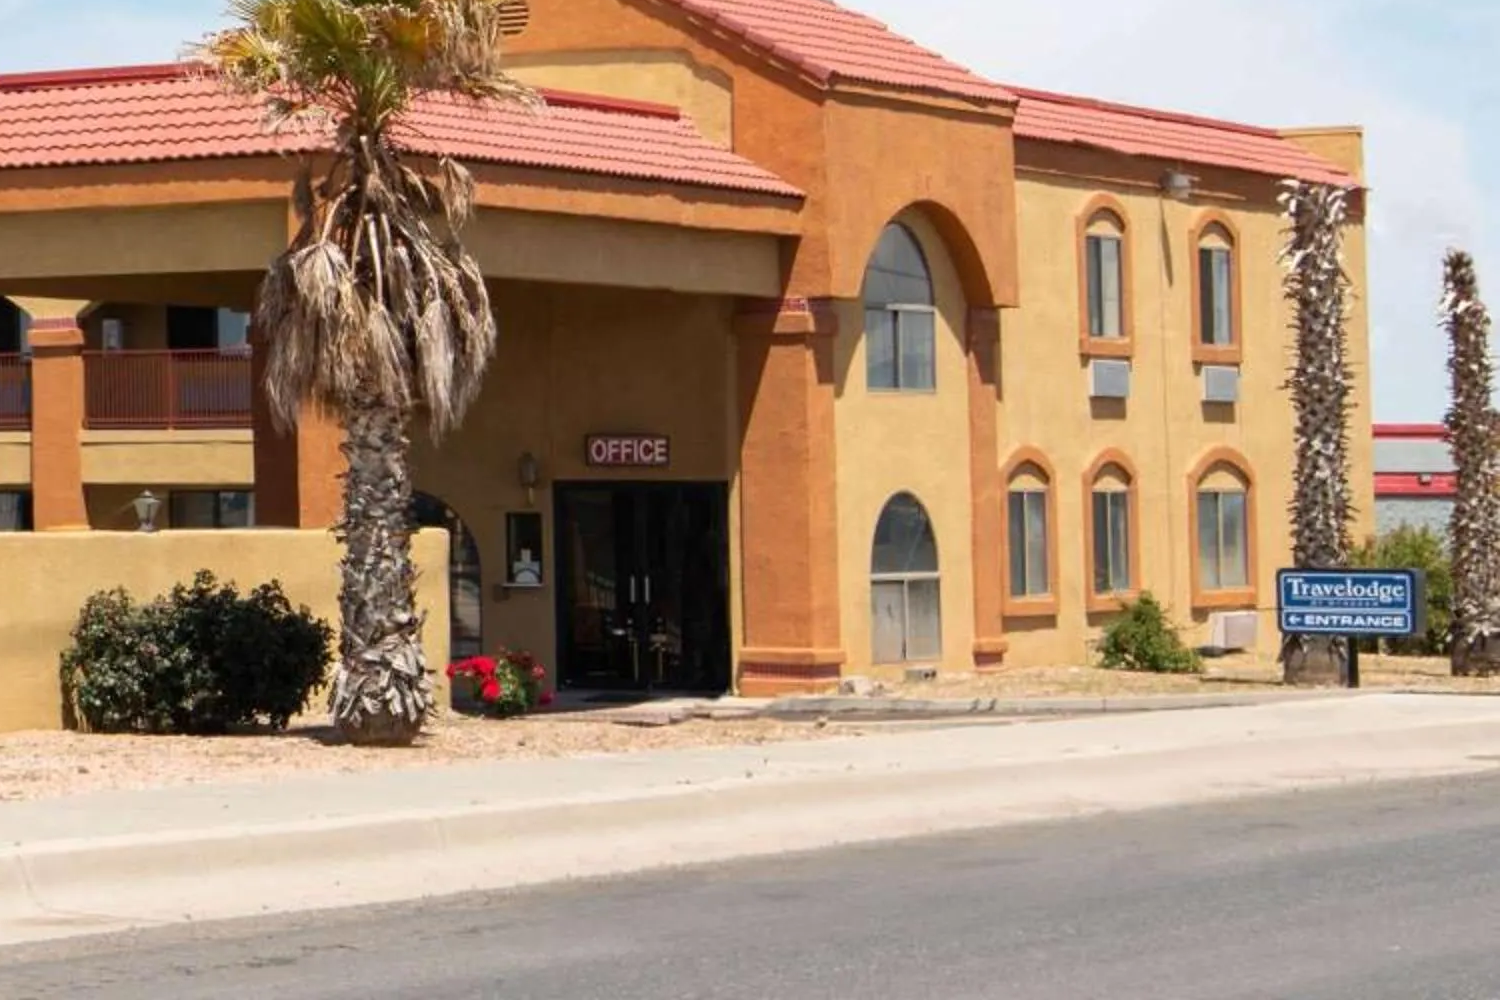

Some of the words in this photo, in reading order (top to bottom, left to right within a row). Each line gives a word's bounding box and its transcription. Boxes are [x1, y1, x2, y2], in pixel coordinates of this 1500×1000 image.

[591, 440, 667, 463] OFFICE
[1286, 578, 1405, 602] Travelodge
[1304, 616, 1404, 627] ENTRANCE
